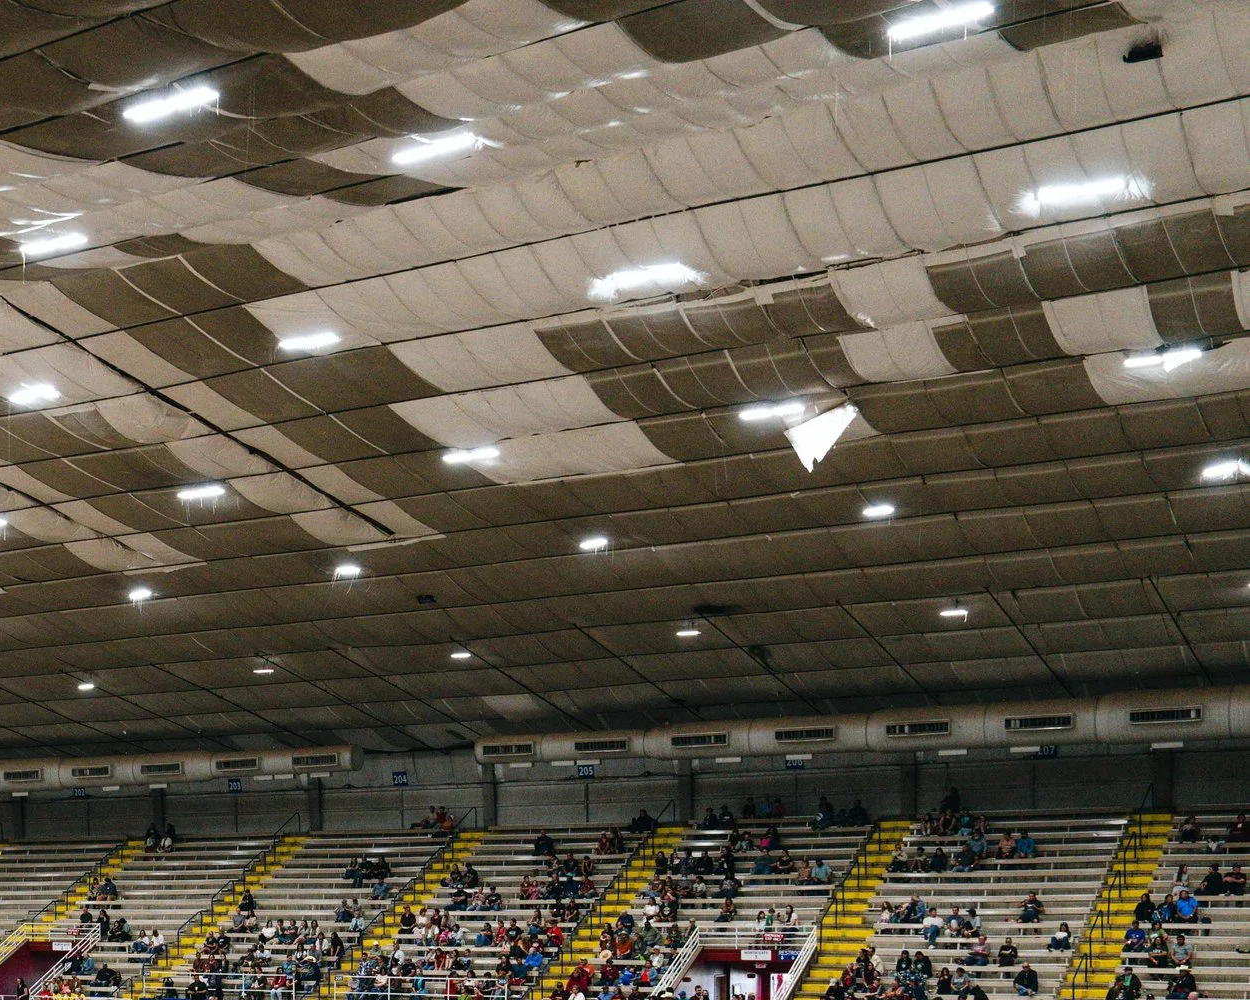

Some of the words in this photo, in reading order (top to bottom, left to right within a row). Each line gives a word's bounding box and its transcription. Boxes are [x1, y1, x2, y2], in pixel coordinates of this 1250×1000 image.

[578, 767, 594, 776] 205
[393, 774, 407, 785] 204
[229, 783, 242, 791] 203
[74, 788, 86, 798] 202
